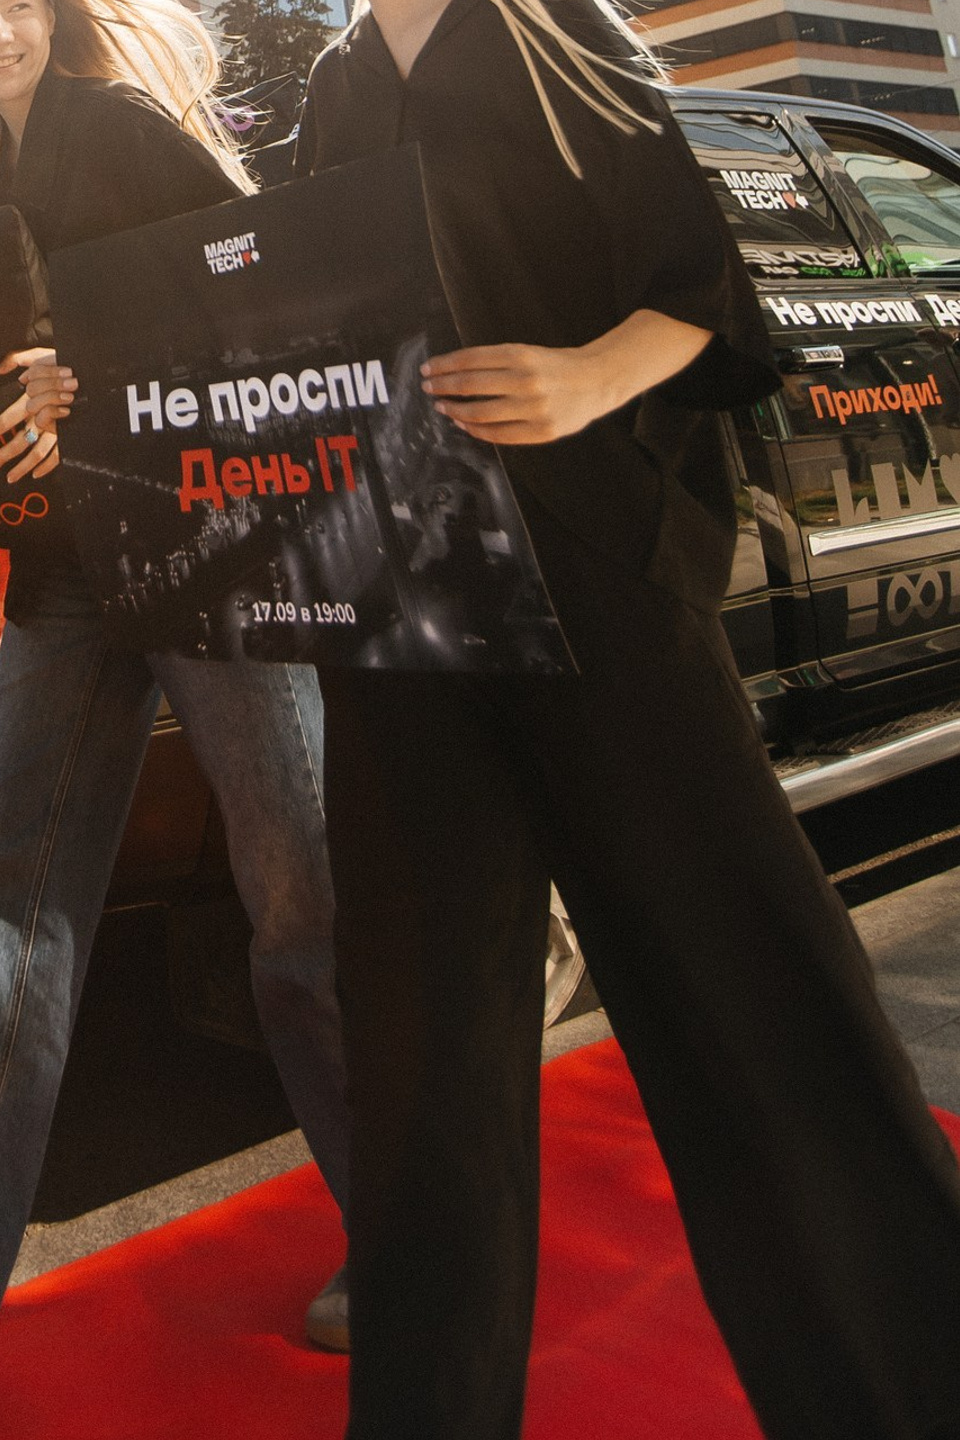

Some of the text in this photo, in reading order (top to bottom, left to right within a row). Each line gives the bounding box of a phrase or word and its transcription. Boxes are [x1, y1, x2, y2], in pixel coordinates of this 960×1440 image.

[719, 169, 797, 192] MAGNIT
[730, 189, 788, 211] TECH
[203, 231, 257, 260] MAGNIT
[206, 251, 245, 275] TECH
[765, 293, 960, 331] Не проспи Де
[126, 360, 390, 434] Не проспи
[809, 373, 943, 425] Приходи!
[178, 435, 359, 513] День IT
[252, 601, 356, 624] 17.09 в 19:00
